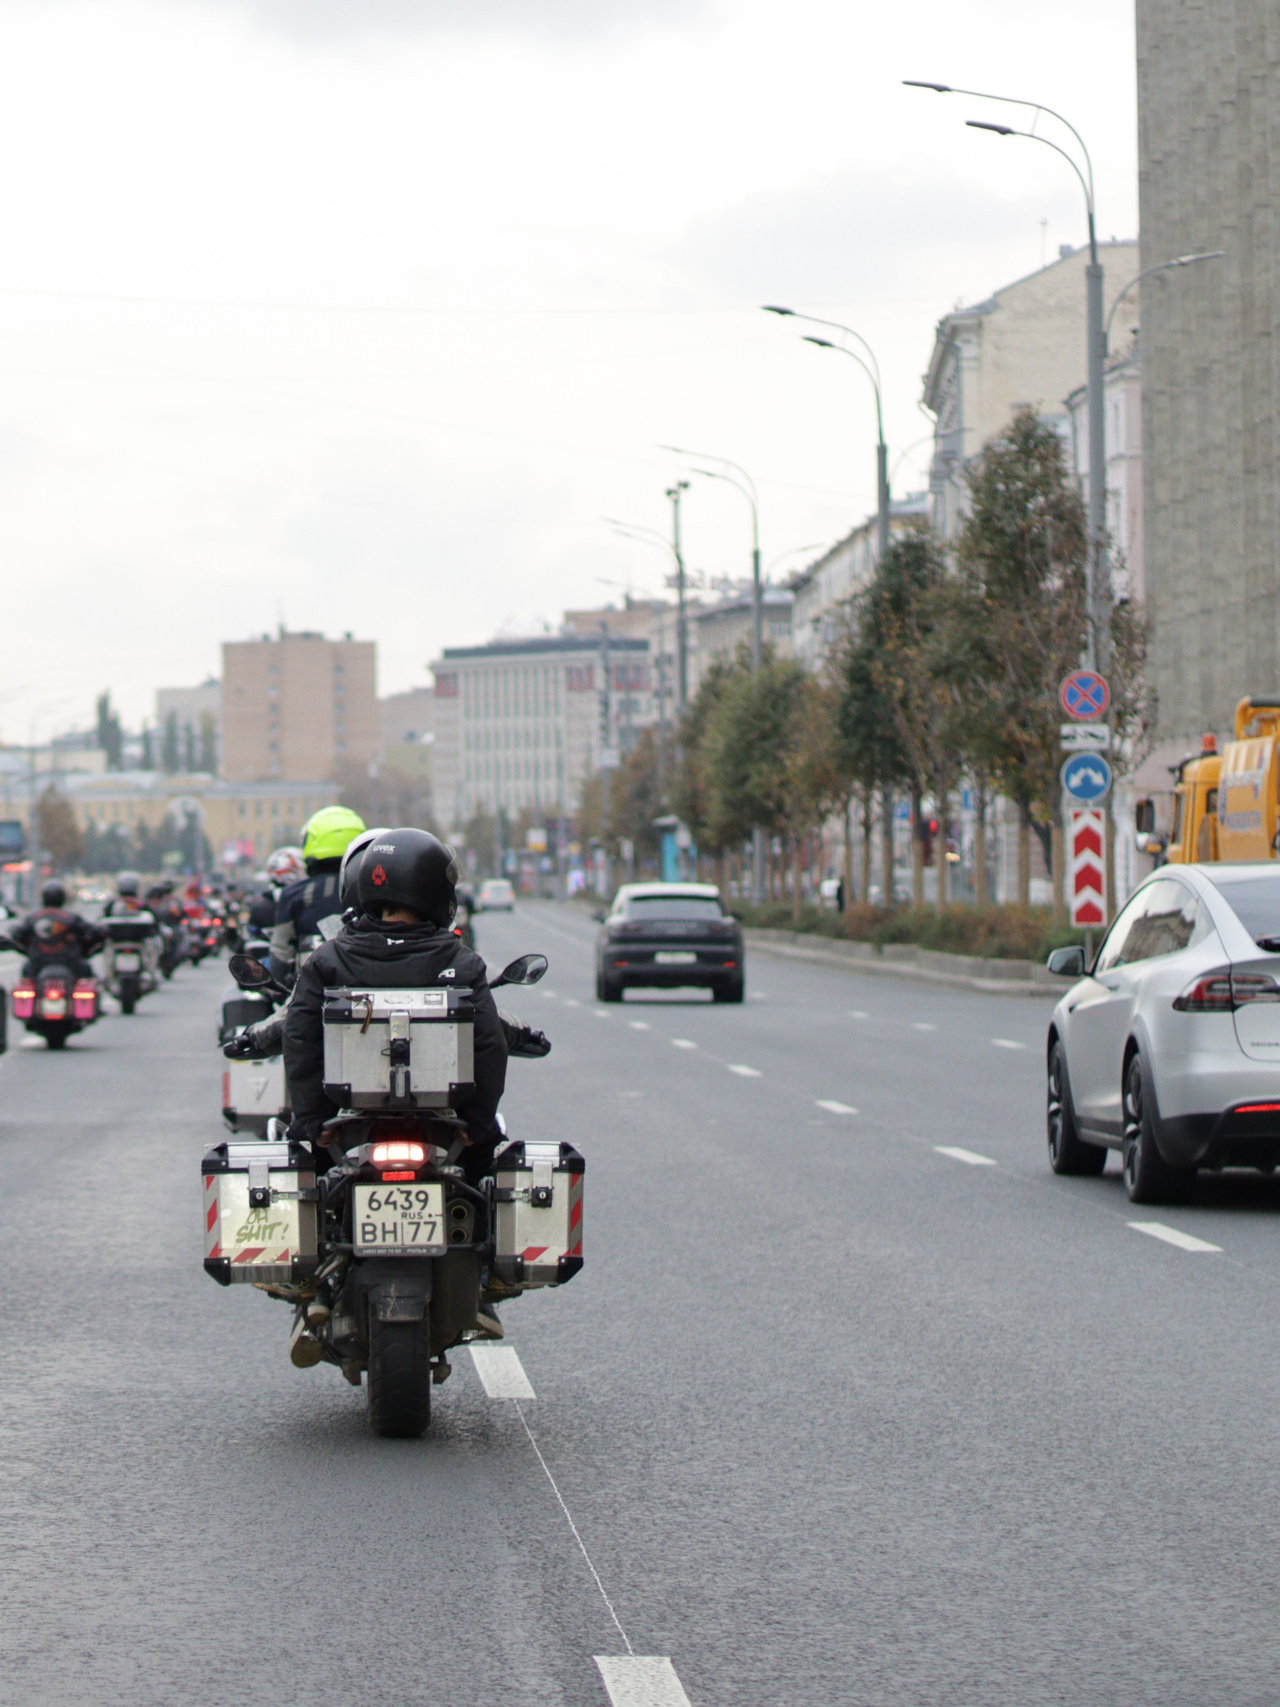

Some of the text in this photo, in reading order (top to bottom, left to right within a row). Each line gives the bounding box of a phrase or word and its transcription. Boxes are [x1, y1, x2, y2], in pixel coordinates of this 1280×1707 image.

[368, 1189, 429, 1212] 6439
[401, 1212, 424, 1220] RUS
[407, 1220, 437, 1242] 77
